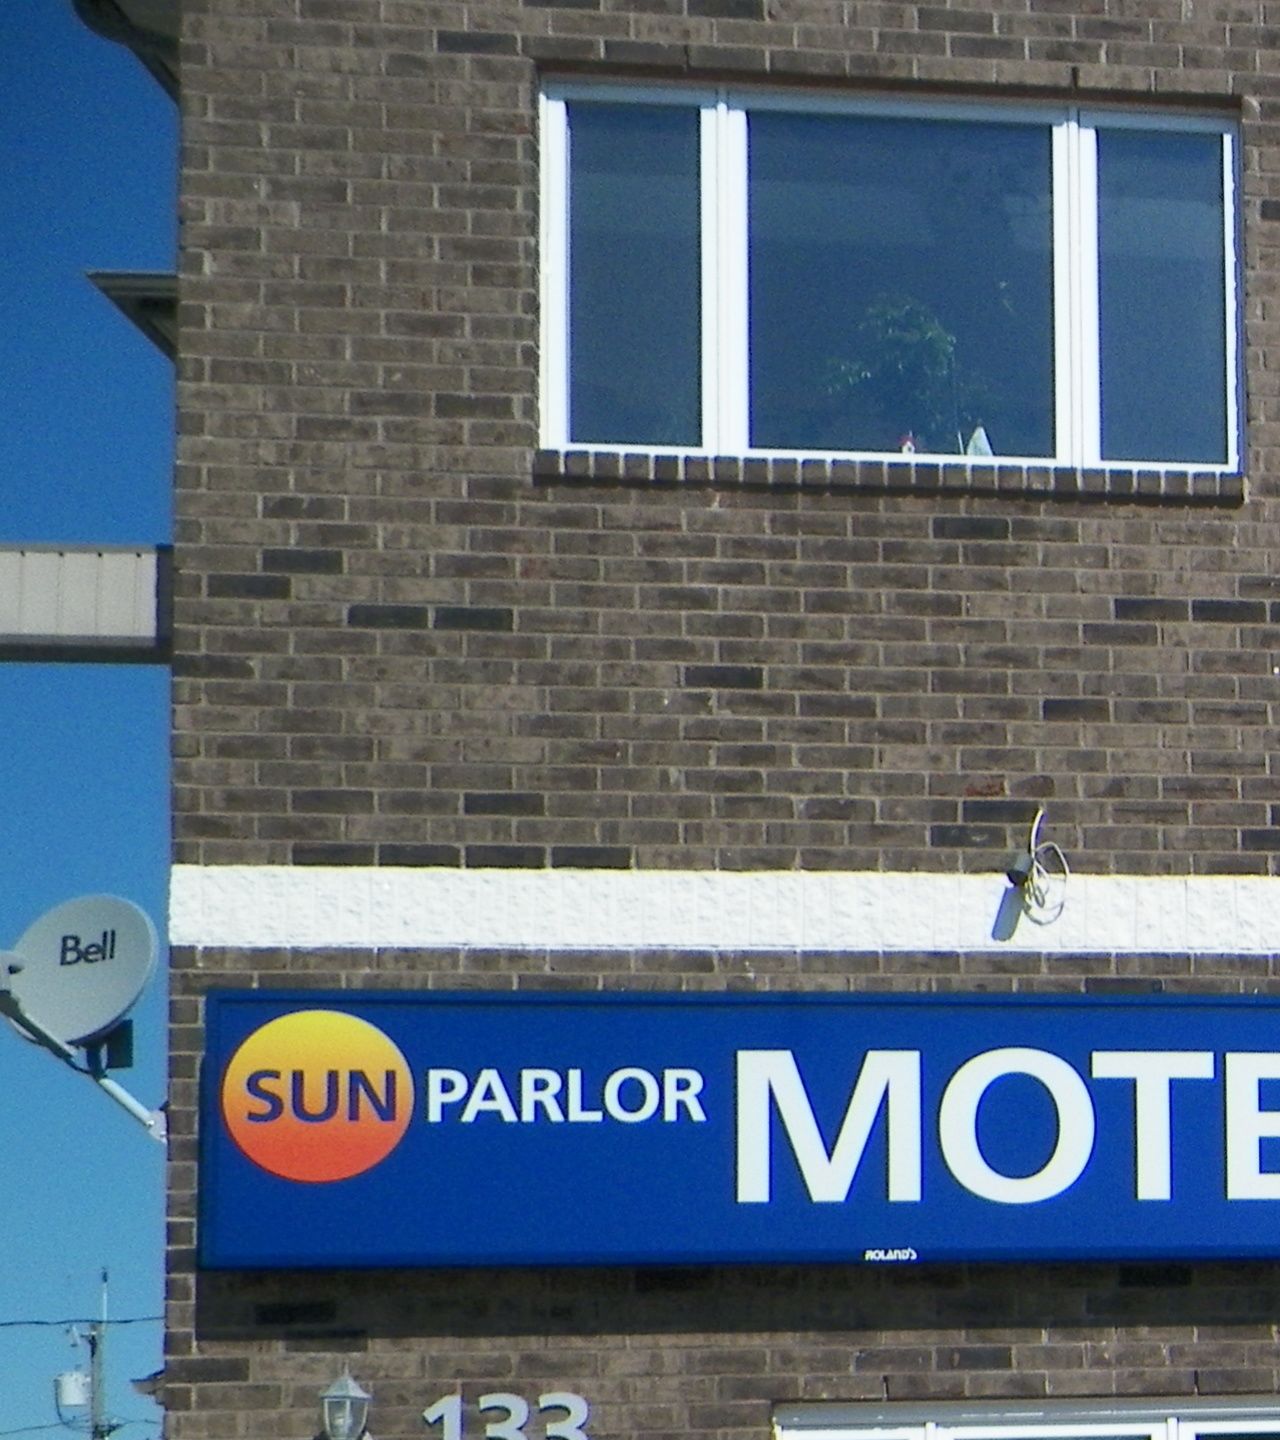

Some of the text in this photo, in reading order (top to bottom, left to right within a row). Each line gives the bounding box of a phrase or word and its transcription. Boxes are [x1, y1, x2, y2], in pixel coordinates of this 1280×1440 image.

[60, 930, 116, 966] Bell
[245, 1068, 397, 1123] SUN
[427, 1067, 708, 1123] PARLOR
